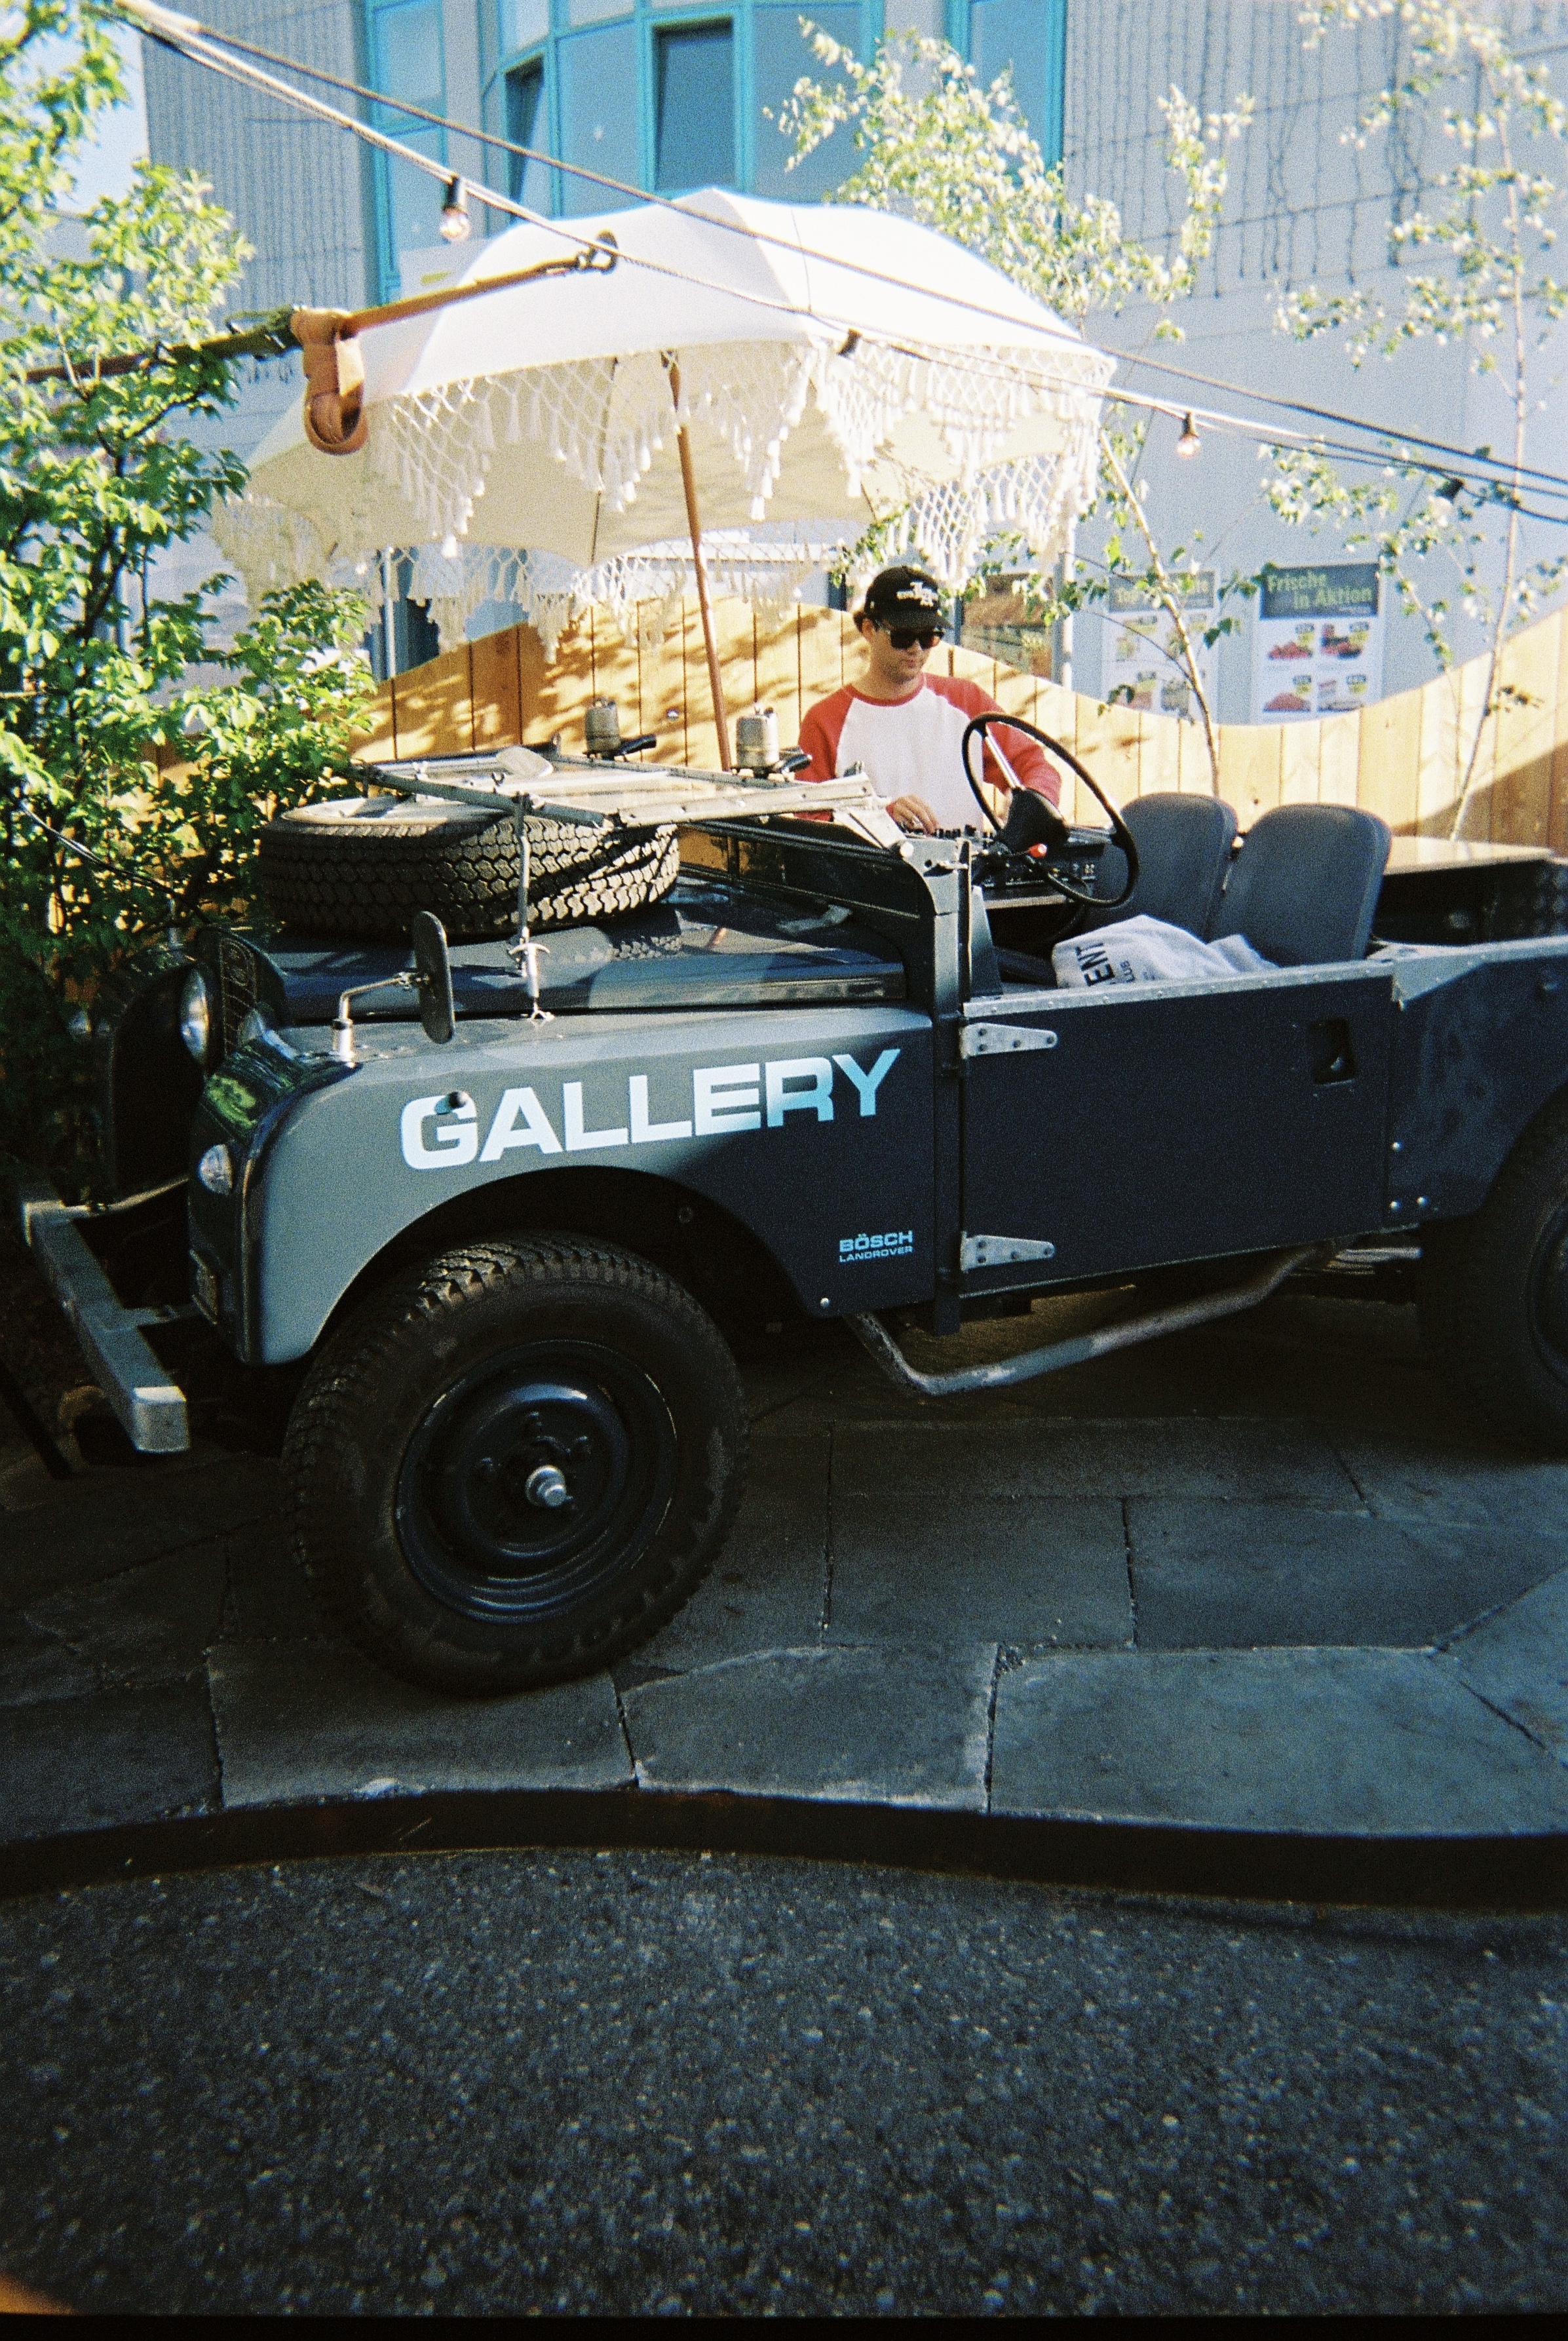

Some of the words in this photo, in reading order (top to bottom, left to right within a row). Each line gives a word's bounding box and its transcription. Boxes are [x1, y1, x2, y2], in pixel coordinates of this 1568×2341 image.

[1267, 570, 1327, 593] Frische
[1315, 586, 1372, 607] Aktion
[400, 1048, 901, 1170] GALLERY
[839, 1230, 913, 1252] BÖSCH
[839, 1246, 913, 1262] LANDROVER
